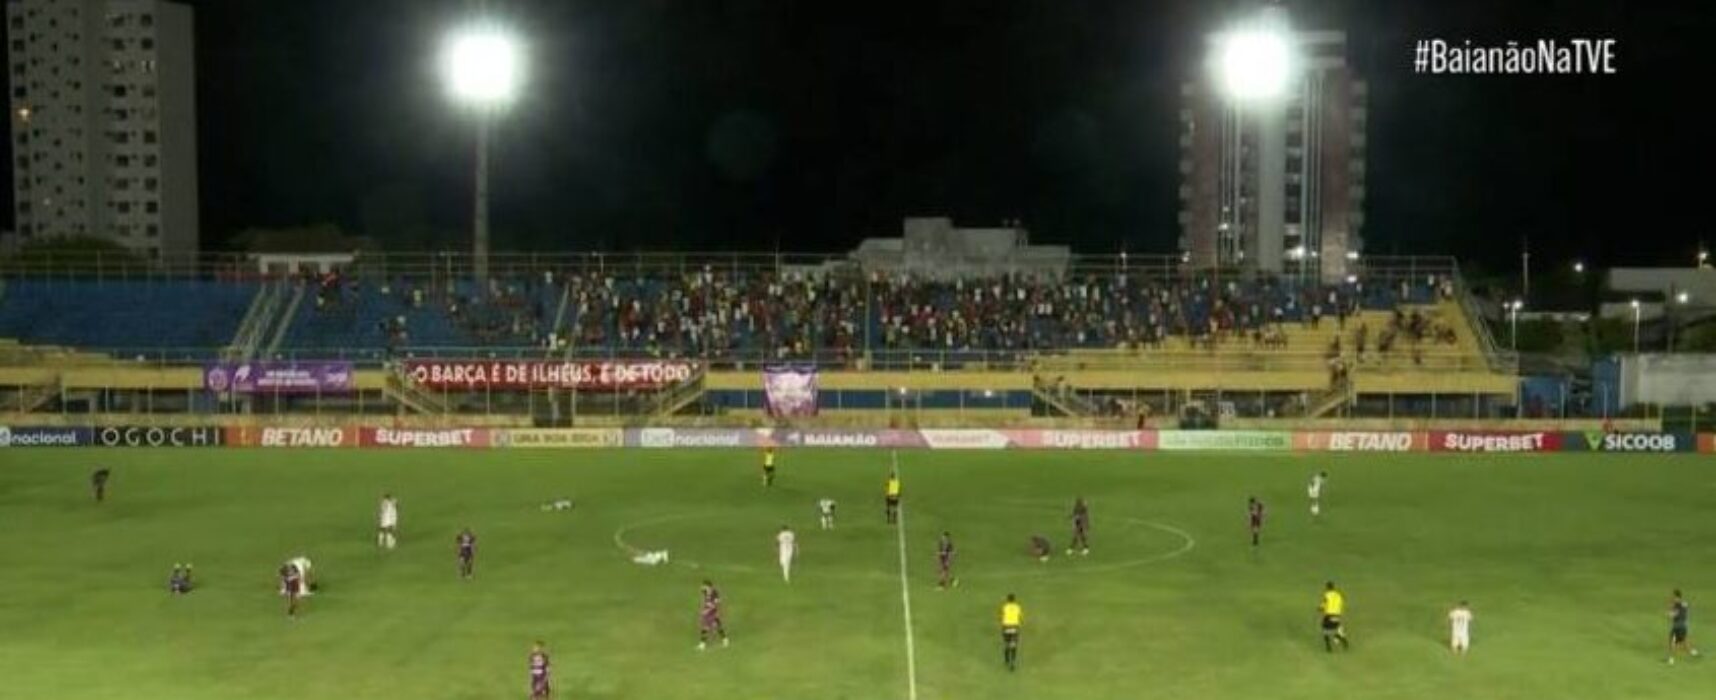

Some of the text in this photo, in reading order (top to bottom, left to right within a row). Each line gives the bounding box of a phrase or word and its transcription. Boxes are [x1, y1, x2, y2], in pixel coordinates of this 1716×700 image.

[432, 364, 486, 386] BARÇA
[492, 362, 501, 382] É
[506, 364, 527, 382] DE
[262, 428, 343, 446] BETANO
[375, 428, 473, 446] SUPERBET
[1330, 432, 1412, 450] BETANO
[1445, 433, 1543, 450] SUPERBET
[1605, 433, 1675, 450] SICOOB
